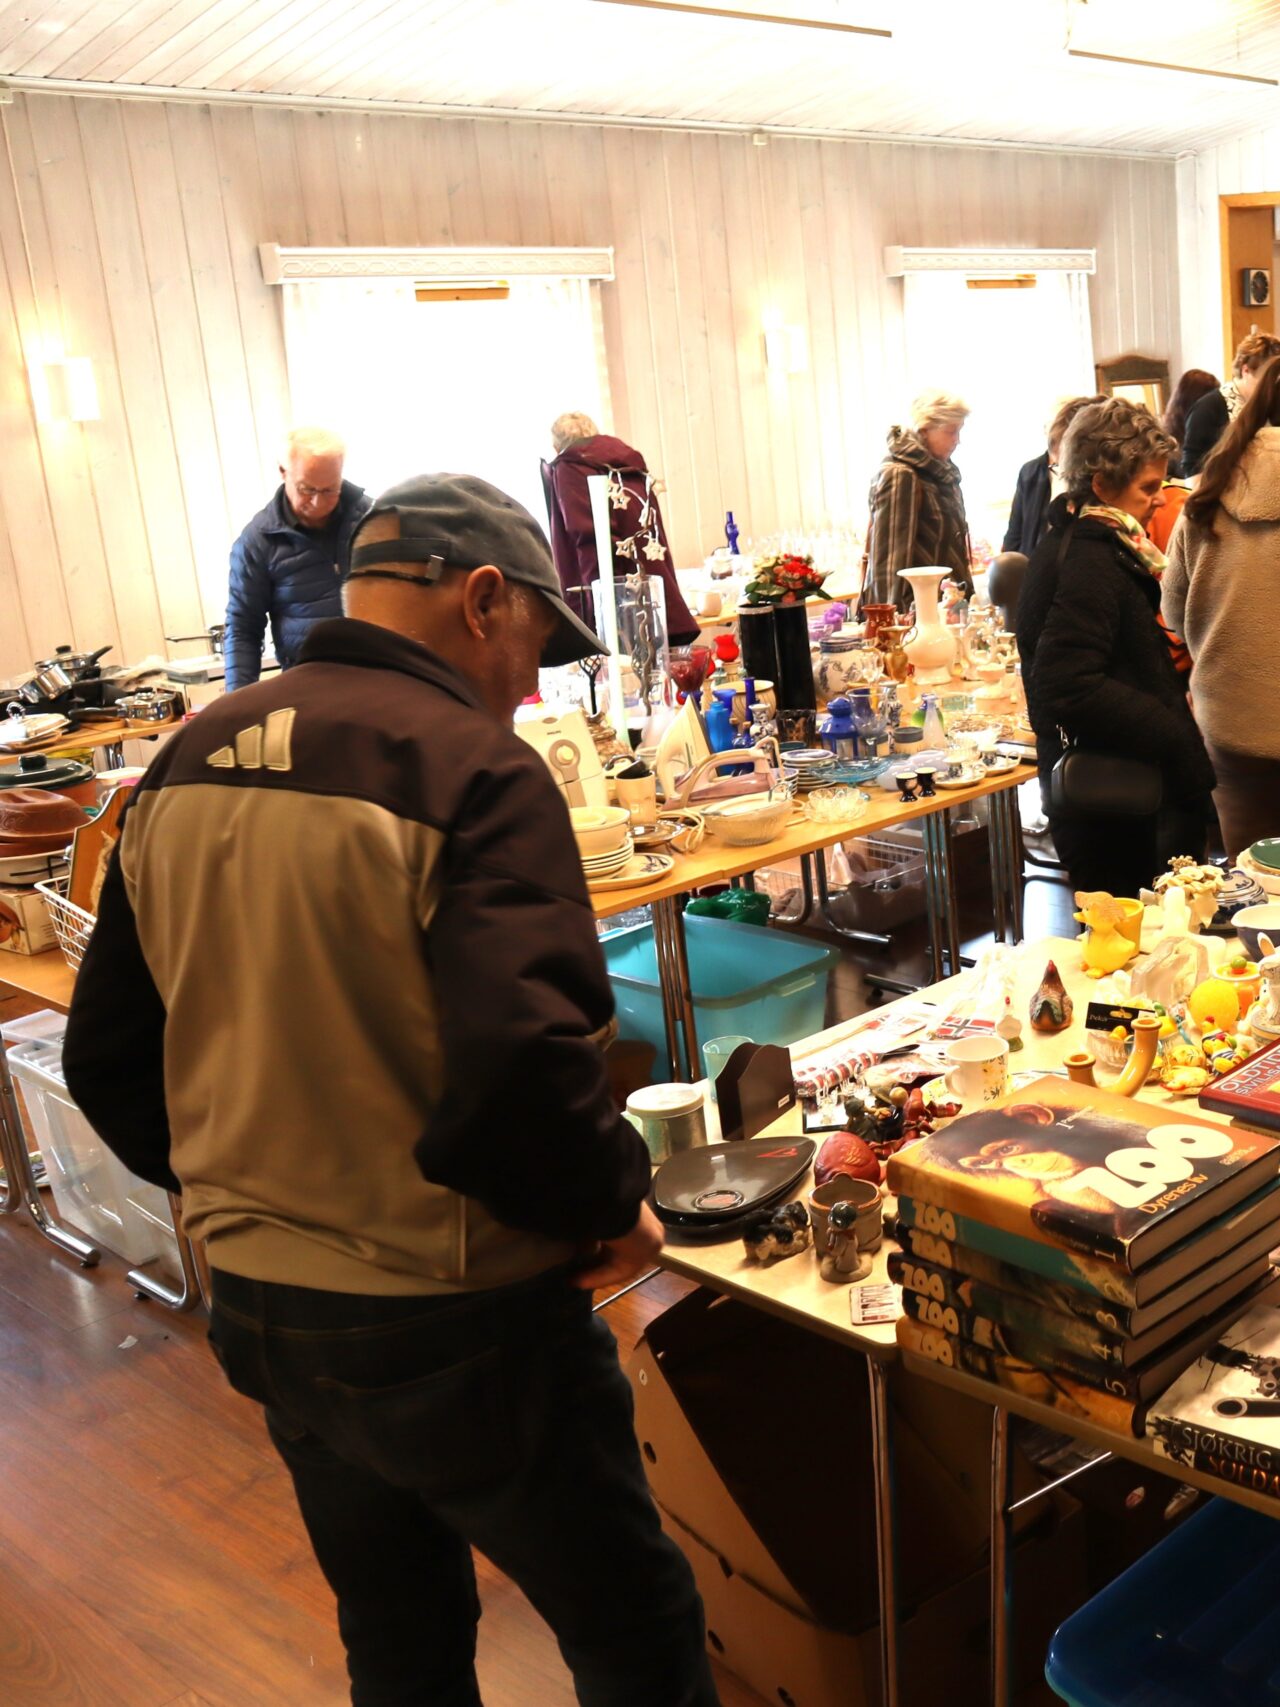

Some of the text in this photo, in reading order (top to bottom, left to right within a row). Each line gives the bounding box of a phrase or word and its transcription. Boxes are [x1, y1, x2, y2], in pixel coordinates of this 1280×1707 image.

[1044, 1124, 1233, 1208] ZOO
[1138, 1173, 1208, 1214] Dyrenes liv
[912, 1201, 956, 1241] ZOO
[908, 1229, 952, 1268] ZOO
[1094, 1249, 1117, 1263] 1
[901, 1263, 945, 1302] ZOO
[916, 1296, 959, 1335] ZOO
[1095, 1311, 1118, 1329] 3
[912, 1330, 953, 1367] ZOO
[1091, 1344, 1112, 1360] 4
[1105, 1379, 1127, 1396] 5
[1181, 1427, 1272, 1469] SJØKRIG
